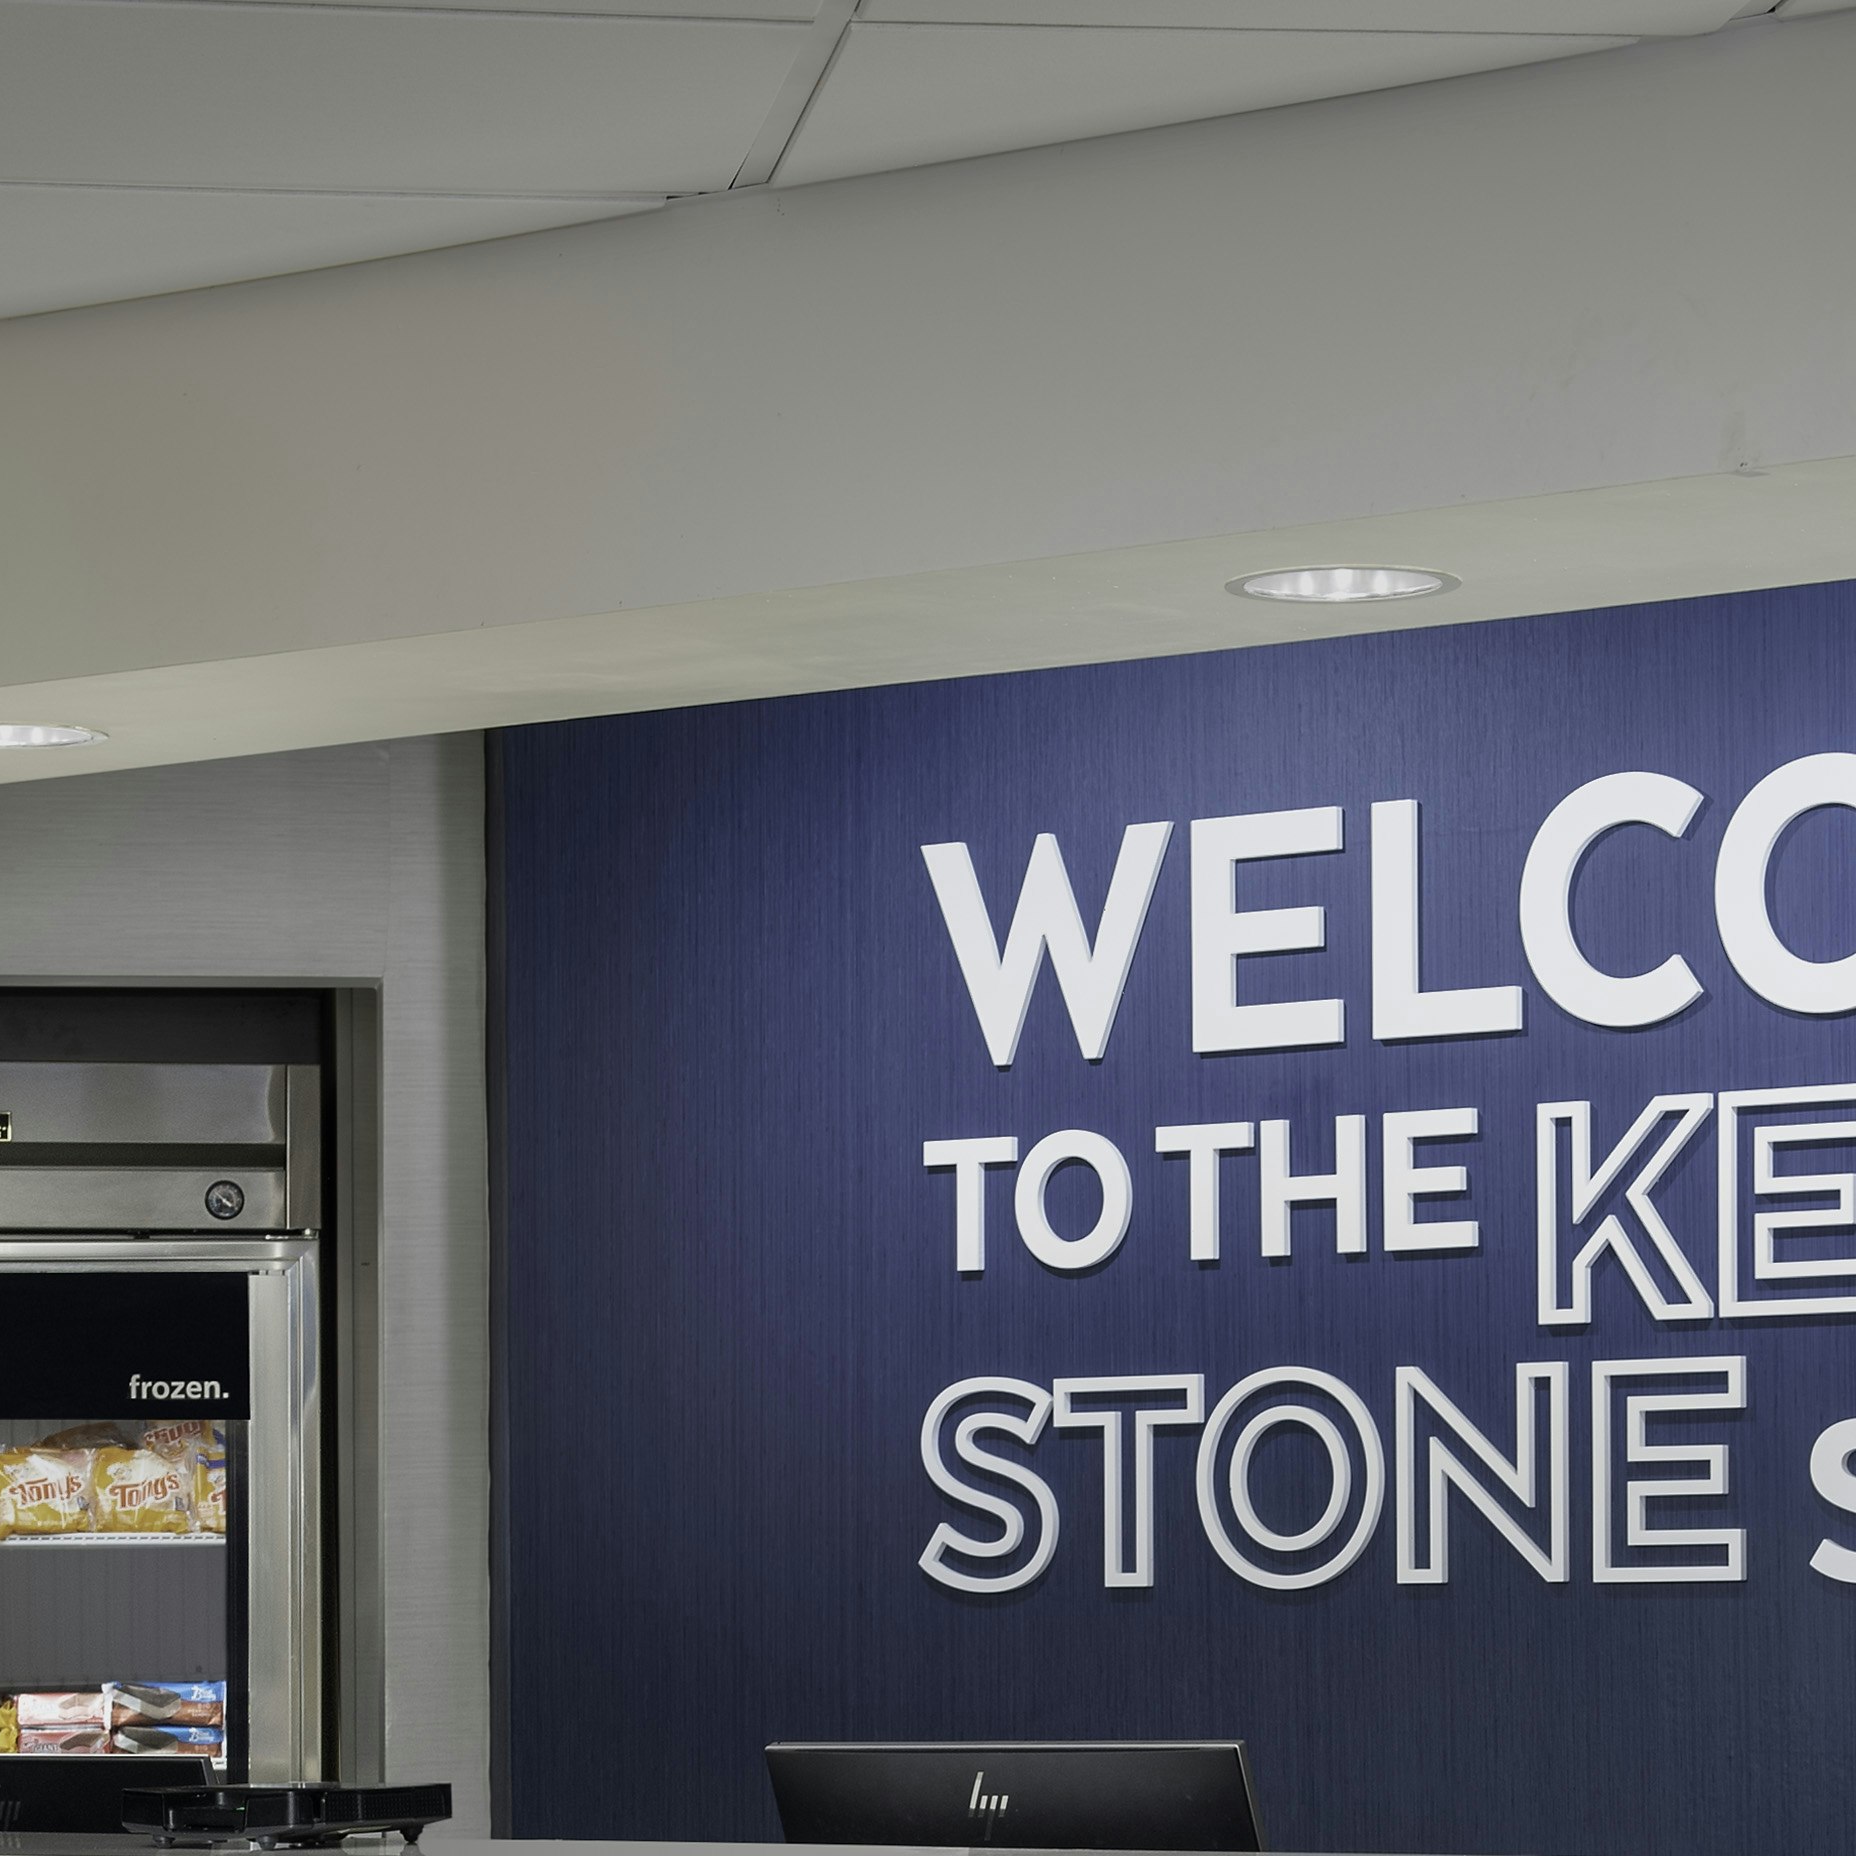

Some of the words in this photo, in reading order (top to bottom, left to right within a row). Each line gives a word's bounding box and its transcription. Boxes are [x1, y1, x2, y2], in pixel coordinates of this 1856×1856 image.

[923, 1129, 1134, 1273] TO
[1154, 1107, 1480, 1263] THE
[129, 1373, 229, 1400] frozen.
[918, 1355, 1749, 1594] STONE
